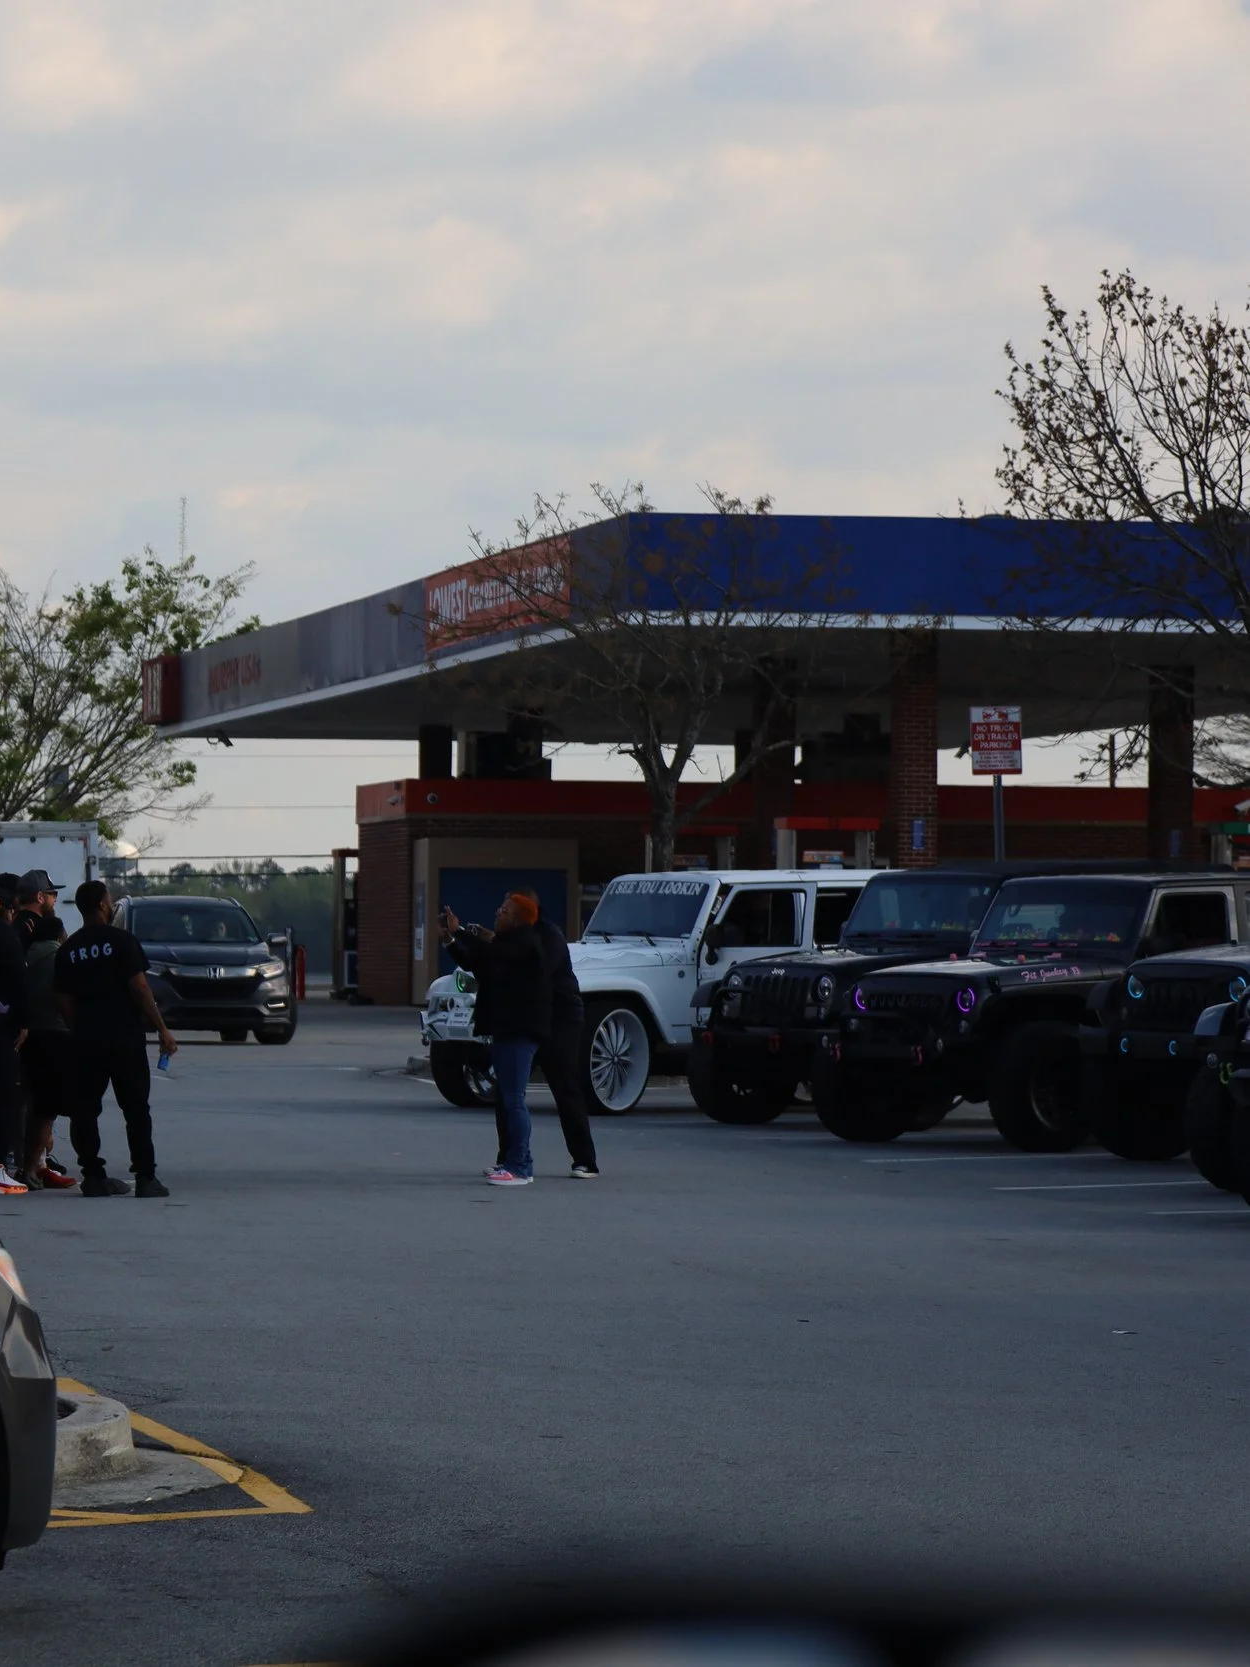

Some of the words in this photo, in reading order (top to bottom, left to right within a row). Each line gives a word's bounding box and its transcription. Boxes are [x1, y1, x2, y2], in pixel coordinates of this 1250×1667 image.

[429, 578, 467, 631] LOWEST
[976, 724, 987, 732] NO
[990, 724, 1015, 732] TRUCK
[609, 882, 616, 895] I
[616, 881, 634, 895] SEE
[637, 881, 659, 894] YOU
[660, 881, 703, 896] LOOKIN
[69, 942, 112, 964] FROG
